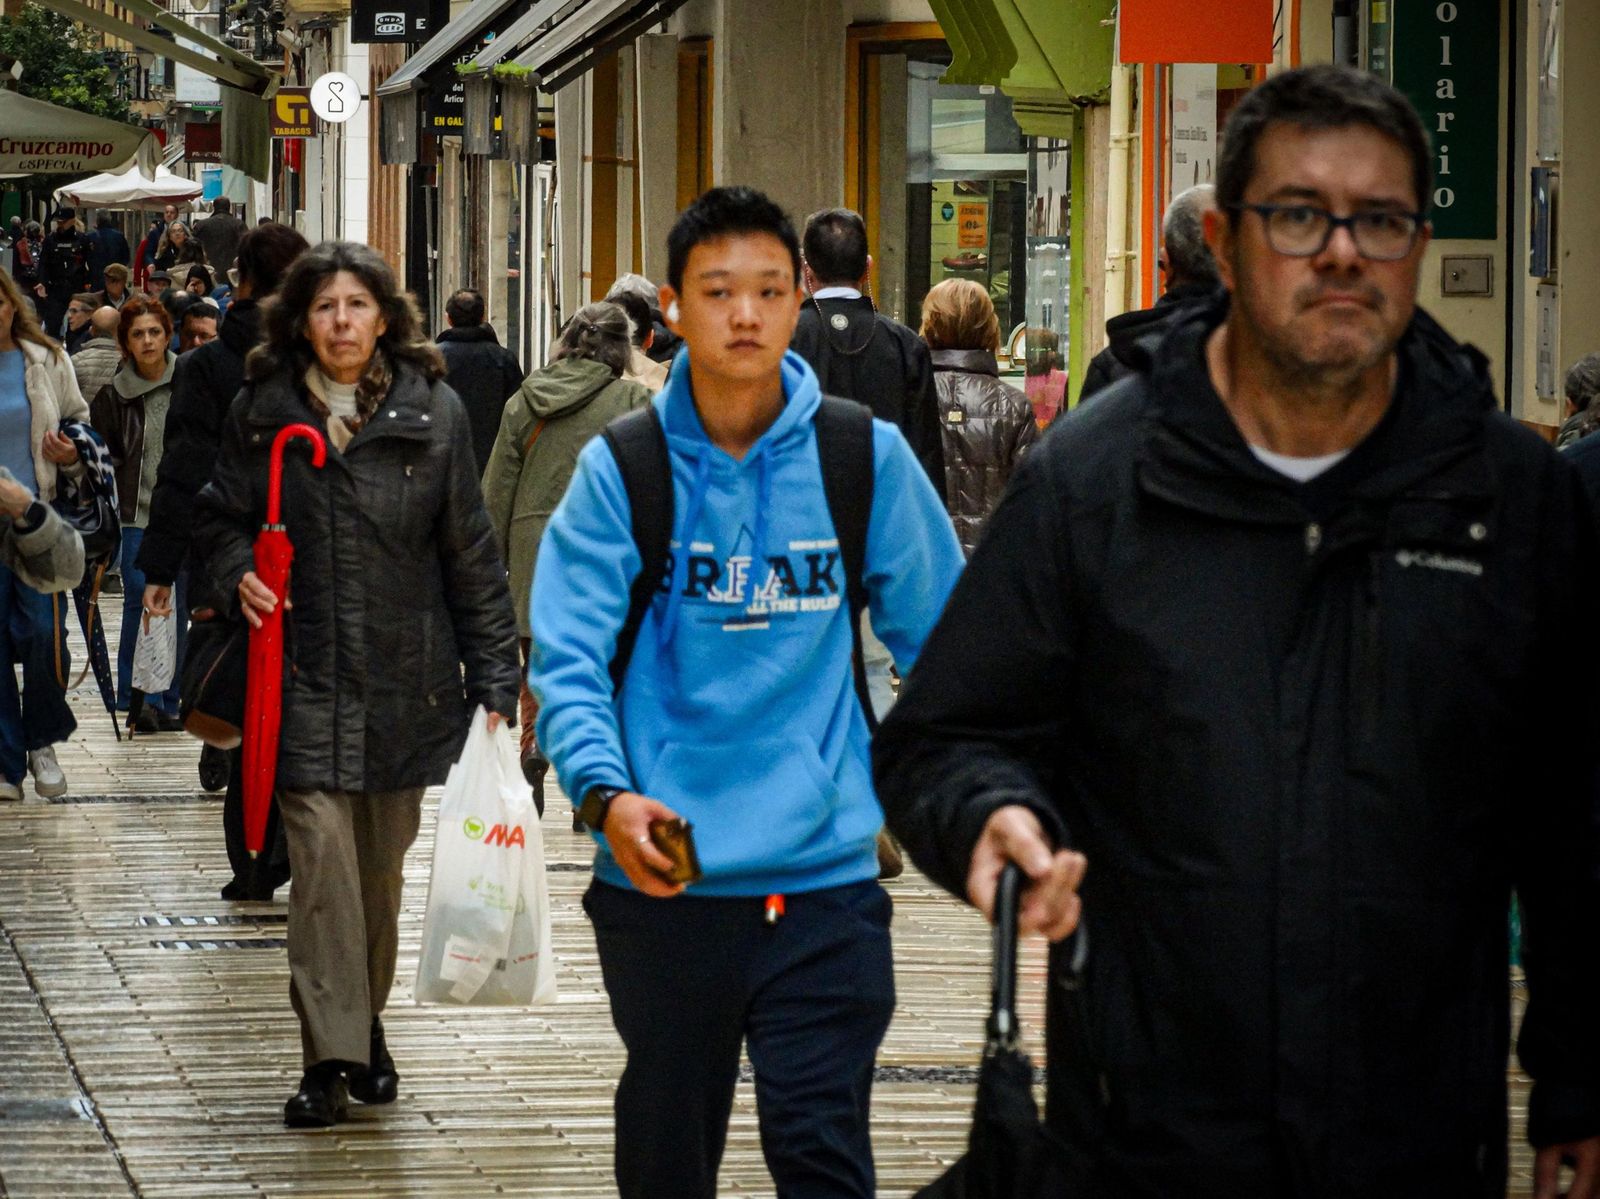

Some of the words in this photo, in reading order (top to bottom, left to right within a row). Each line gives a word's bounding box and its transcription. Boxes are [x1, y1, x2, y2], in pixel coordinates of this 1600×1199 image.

[444, 94, 464, 103] Articu
[434, 117, 445, 126] EN
[447, 117, 464, 126] GAL
[273, 127, 312, 136] TABACOS
[0, 137, 114, 159] Cruzcampo
[18, 159, 84, 171] ESPECIAL
